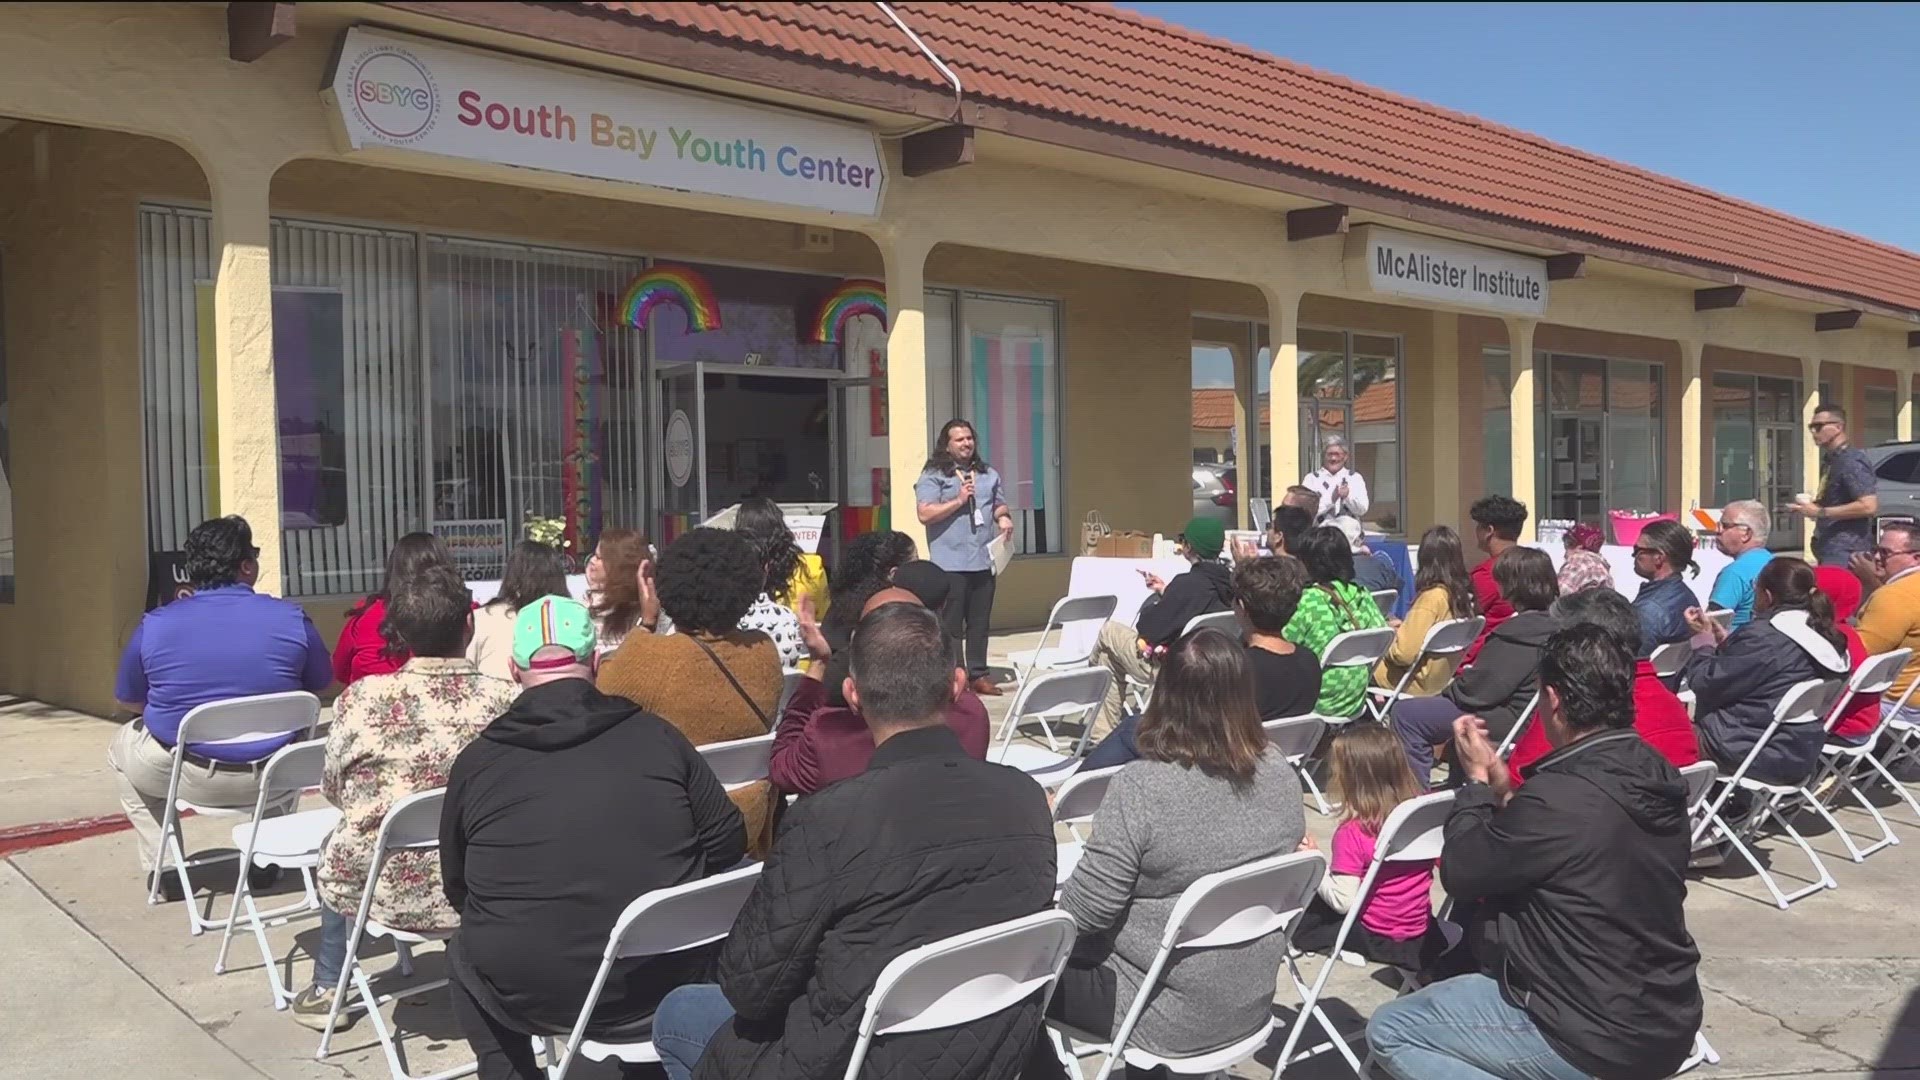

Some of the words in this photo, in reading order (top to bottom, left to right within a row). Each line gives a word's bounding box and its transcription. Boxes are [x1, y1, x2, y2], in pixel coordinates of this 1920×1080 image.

[360, 80, 429, 111] SBYC
[457, 90, 577, 143] South
[590, 113, 658, 161] Bay
[668, 127, 766, 172] Youth
[776, 145, 875, 189] Center
[1377, 246, 1467, 289] McAlister
[1473, 265, 1540, 301] Institute
[794, 530, 817, 540] NTER
[464, 568, 503, 581] COME
